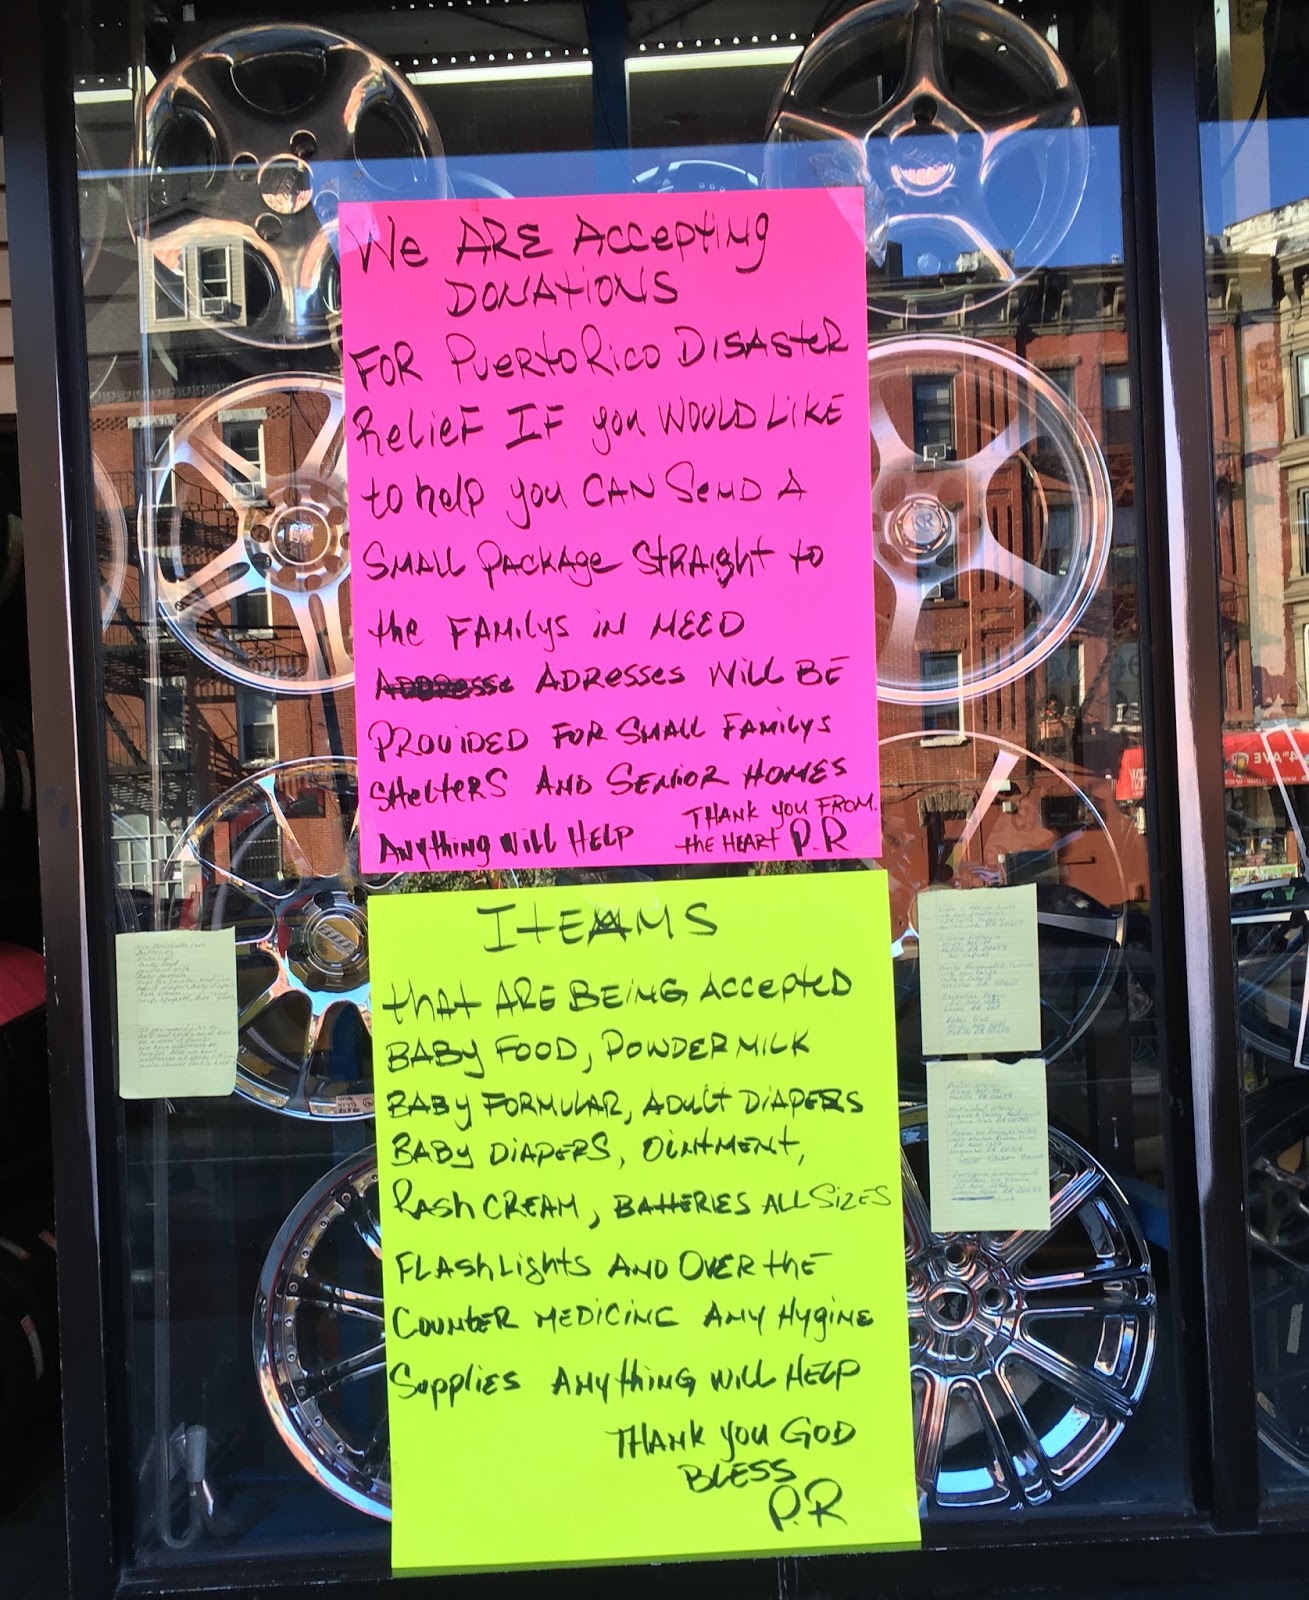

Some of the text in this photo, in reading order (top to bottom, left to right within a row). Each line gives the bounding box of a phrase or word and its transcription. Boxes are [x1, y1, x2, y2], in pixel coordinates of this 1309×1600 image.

[346, 217, 428, 273] We
[456, 217, 552, 266] ARE
[349, 341, 422, 391] FOR
[506, 403, 564, 450] IF
[592, 407, 645, 455] you
[660, 396, 756, 434] WOULD
[767, 394, 844, 431] LIKE
[361, 478, 403, 519] to
[416, 473, 484, 518] help
[507, 477, 567, 529] you
[583, 473, 654, 507] CAN
[778, 468, 806, 499] A
[363, 541, 466, 580] SMALL
[789, 539, 823, 573] to
[368, 610, 422, 646] the
[651, 610, 744, 640] NEED
[796, 657, 848, 685] BE
[552, 720, 607, 749] FOR
[616, 716, 705, 745] SMALL
[536, 765, 592, 795] AND
[743, 757, 847, 789] HOMES
[682, 800, 758, 829] THANK
[568, 820, 634, 855] HELP
[496, 976, 555, 1017] ARE
[602, 1029, 727, 1062] POWDER
[737, 1030, 809, 1057] MILK
[762, 1190, 810, 1214] ALL
[608, 1253, 668, 1279] AND
[679, 1250, 755, 1281] OVER
[703, 1300, 766, 1336] ANY
[786, 1353, 860, 1391] HELP
[606, 1419, 705, 1459] THANK
[780, 1416, 856, 1449] GOD
[677, 1458, 797, 1493] BLESS
